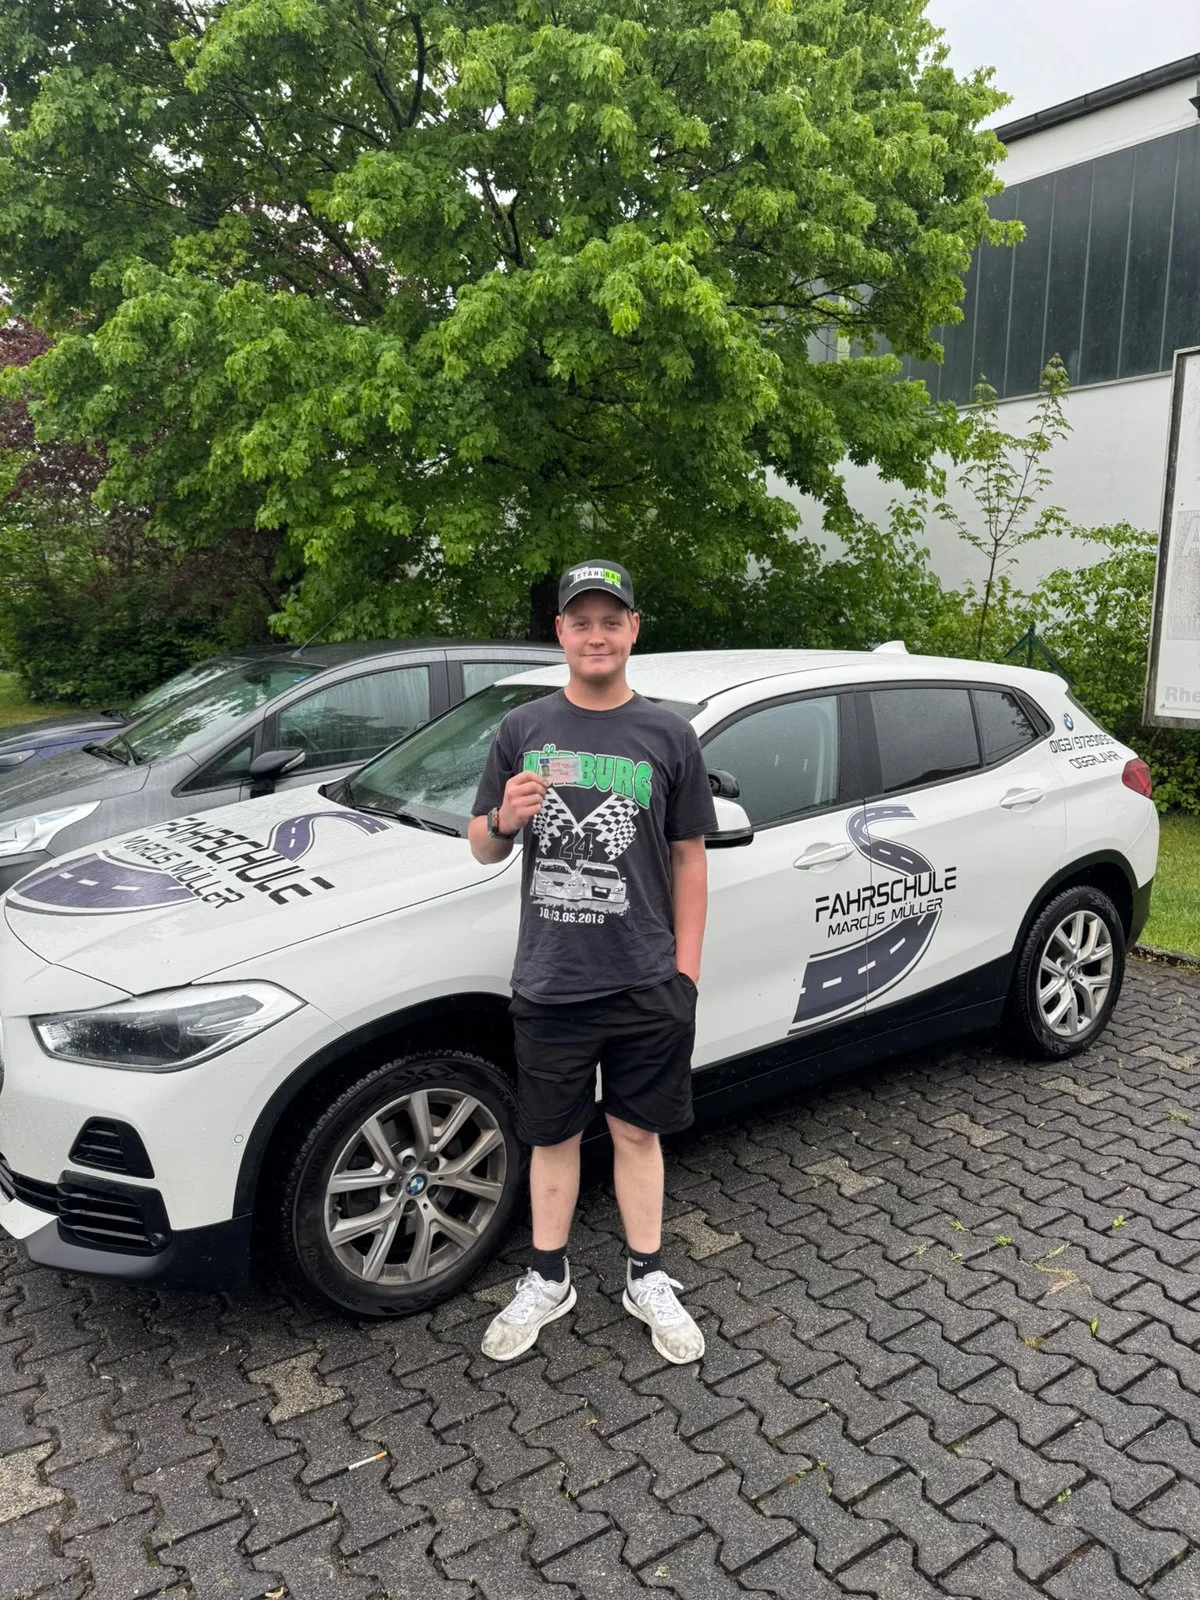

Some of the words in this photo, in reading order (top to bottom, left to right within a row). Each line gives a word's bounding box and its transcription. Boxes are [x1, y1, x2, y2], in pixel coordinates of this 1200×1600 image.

[119, 835, 183, 864] MARCUS
[164, 860, 245, 908] MÜLLER
[147, 817, 336, 905] FAHRSCHULE
[558, 829, 593, 861] 24
[815, 866, 957, 923] FAHRSCHULE
[827, 911, 885, 938] MARCUS
[890, 897, 944, 922] MÜLLER
